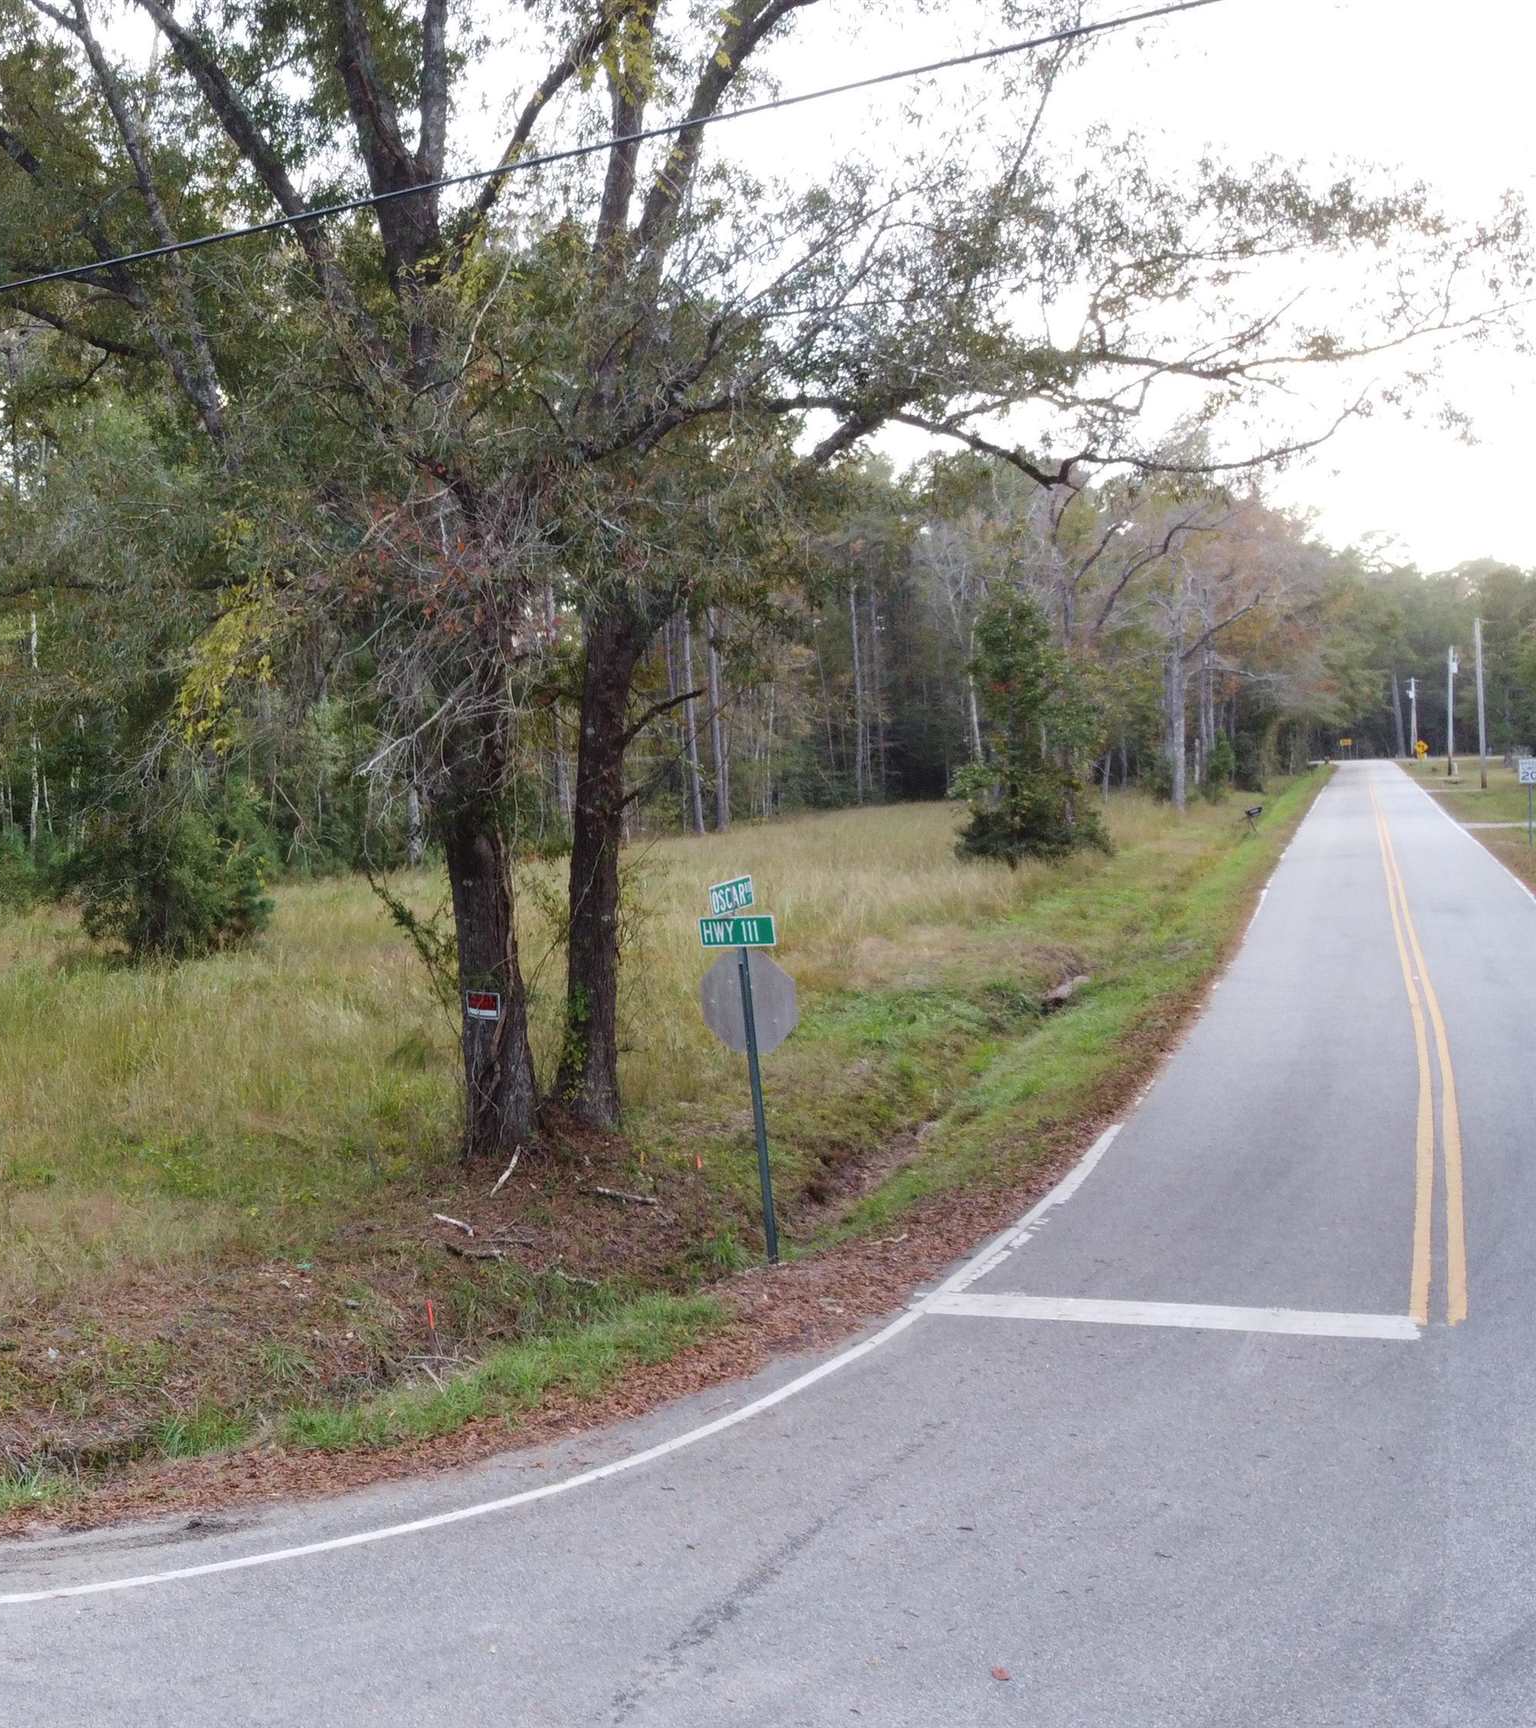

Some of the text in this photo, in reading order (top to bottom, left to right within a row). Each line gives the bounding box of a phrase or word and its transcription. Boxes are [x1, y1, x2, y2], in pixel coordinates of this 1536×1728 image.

[712, 883, 746, 913] OSCAR
[702, 920, 760, 943] HWY 111
